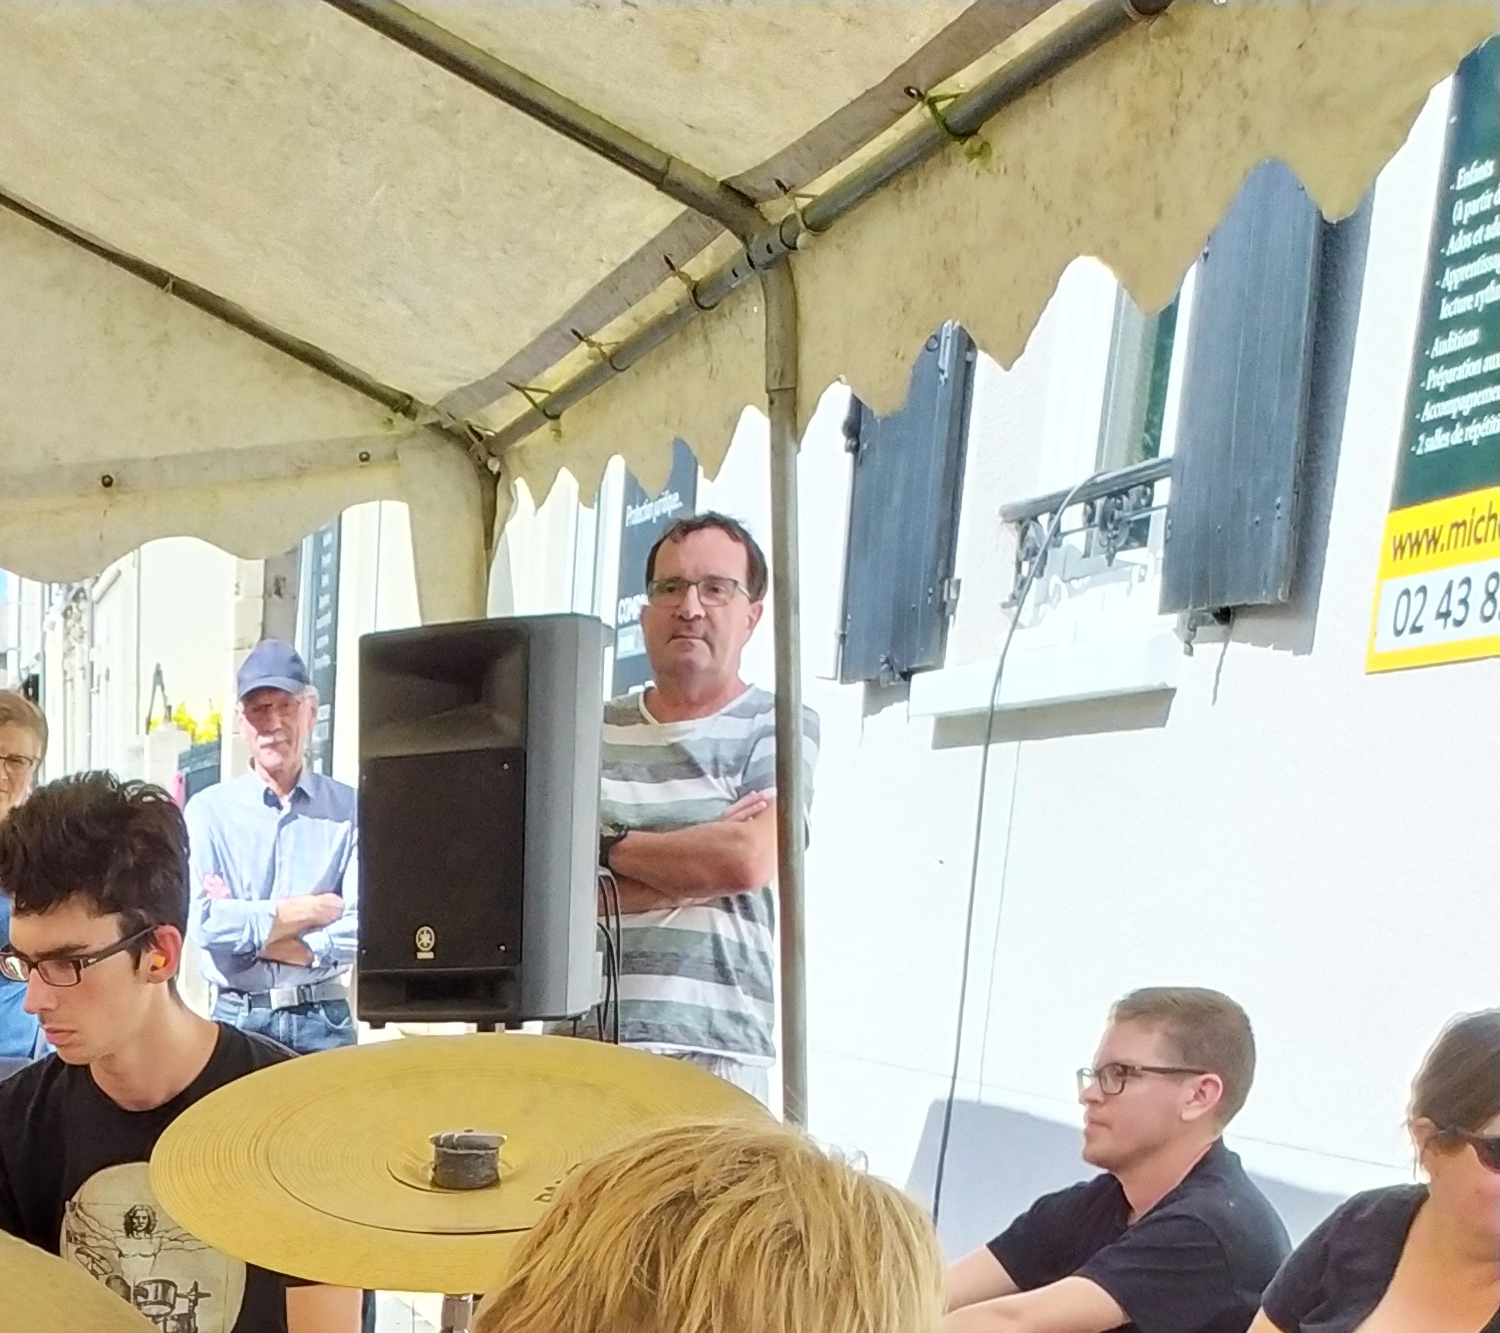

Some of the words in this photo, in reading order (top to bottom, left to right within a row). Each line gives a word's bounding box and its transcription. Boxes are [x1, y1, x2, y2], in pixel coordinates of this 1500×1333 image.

[1392, 500, 1500, 563] www.mich
[1393, 585, 1428, 638] 02
[1434, 576, 1473, 631] 43
[1479, 570, 1500, 625] 8
